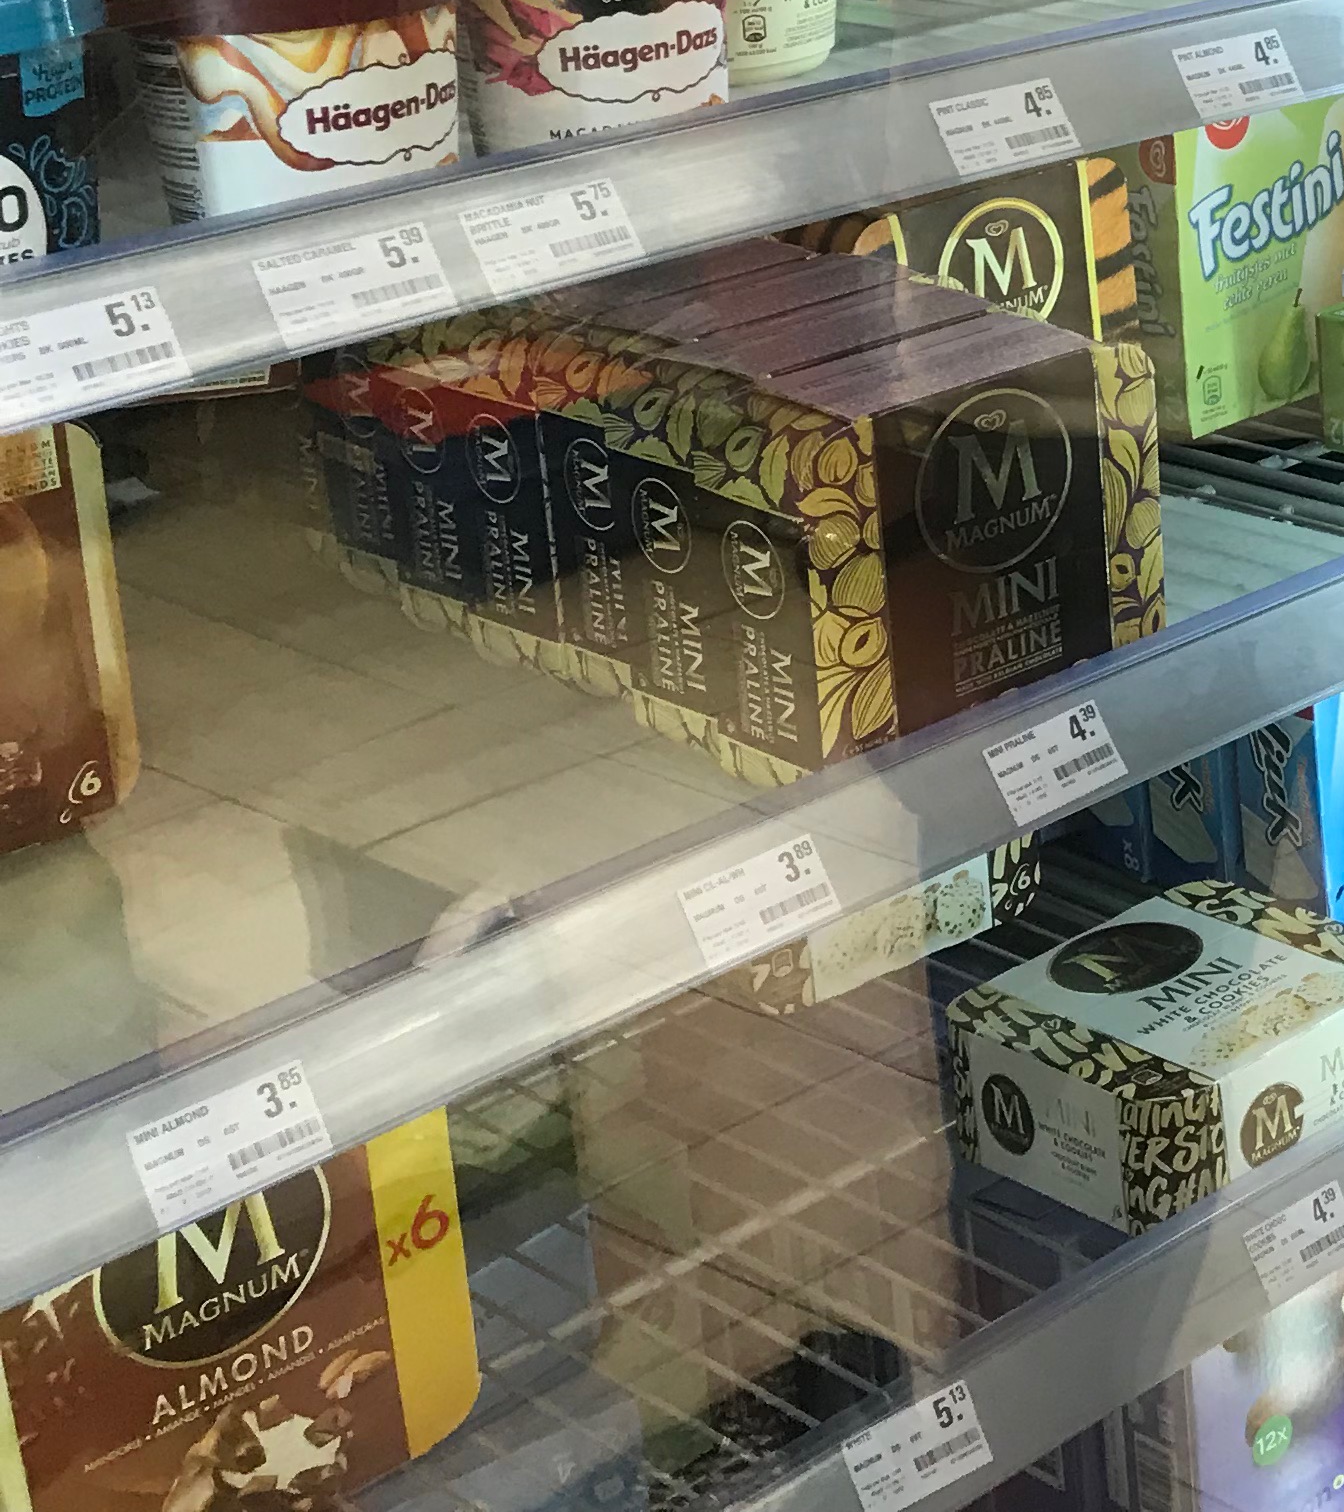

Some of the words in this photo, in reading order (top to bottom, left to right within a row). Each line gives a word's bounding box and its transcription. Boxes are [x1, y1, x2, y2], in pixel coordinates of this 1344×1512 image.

[558, 26, 718, 73] Häagen-Dazs
[1254, 36, 1281, 66] 4.85
[1023, 85, 1053, 118] 4.85
[470, 216, 512, 236] BRITTLE
[526, 194, 545, 208] NUT
[570, 181, 612, 221] 5.75
[257, 251, 302, 271] SALTED
[303, 241, 357, 262] CARAMEL
[378, 225, 424, 269] 5.99
[105, 291, 156, 338] 5.13
[947, 418, 1044, 526] M
[438, 499, 464, 581] MINI
[638, 488, 654, 553] MAGNUM
[649, 498, 681, 551] M
[945, 499, 1055, 553] MAGNUM
[486, 509, 510, 616] PRALINE
[510, 529, 537, 615] MINI
[585, 538, 607, 645] PRALINE
[730, 531, 745, 598] MAGNUM
[739, 544, 773, 597] M
[949, 556, 1059, 637] MINI
[652, 579, 679, 692] PRALINE
[678, 601, 707, 693] MINI
[953, 619, 1062, 679] PRALINE
[740, 623, 768, 740] PRALINE
[769, 648, 798, 744] MINI
[1004, 730, 1037, 752] PRALINE
[1068, 703, 1098, 742] 4.39
[778, 839, 813, 883] 3.89
[1137, 956, 1244, 1013] MINI
[1137, 1006, 1193, 1037] WHITE
[1194, 953, 1288, 1006] CHOCOLATE
[1185, 1012, 1198, 1025] &
[1198, 975, 1271, 1016] COOKIES
[134, 1127, 158, 1146] MINI
[161, 1104, 210, 1135] ALMOND
[256, 1066, 304, 1119] 3.85
[990, 1082, 1025, 1135] M
[1251, 1094, 1293, 1151] M
[1250, 1128, 1301, 1164] MAGNUM
[385, 1194, 450, 1267] x6
[1311, 1186, 1337, 1224] 4.39
[142, 1253, 301, 1352] MAGNUM
[151, 1324, 315, 1426] ALMOND
[845, 1431, 873, 1449] WHITE
[933, 1384, 967, 1430] 5.13
[1255, 1425, 1289, 1457] 12x
